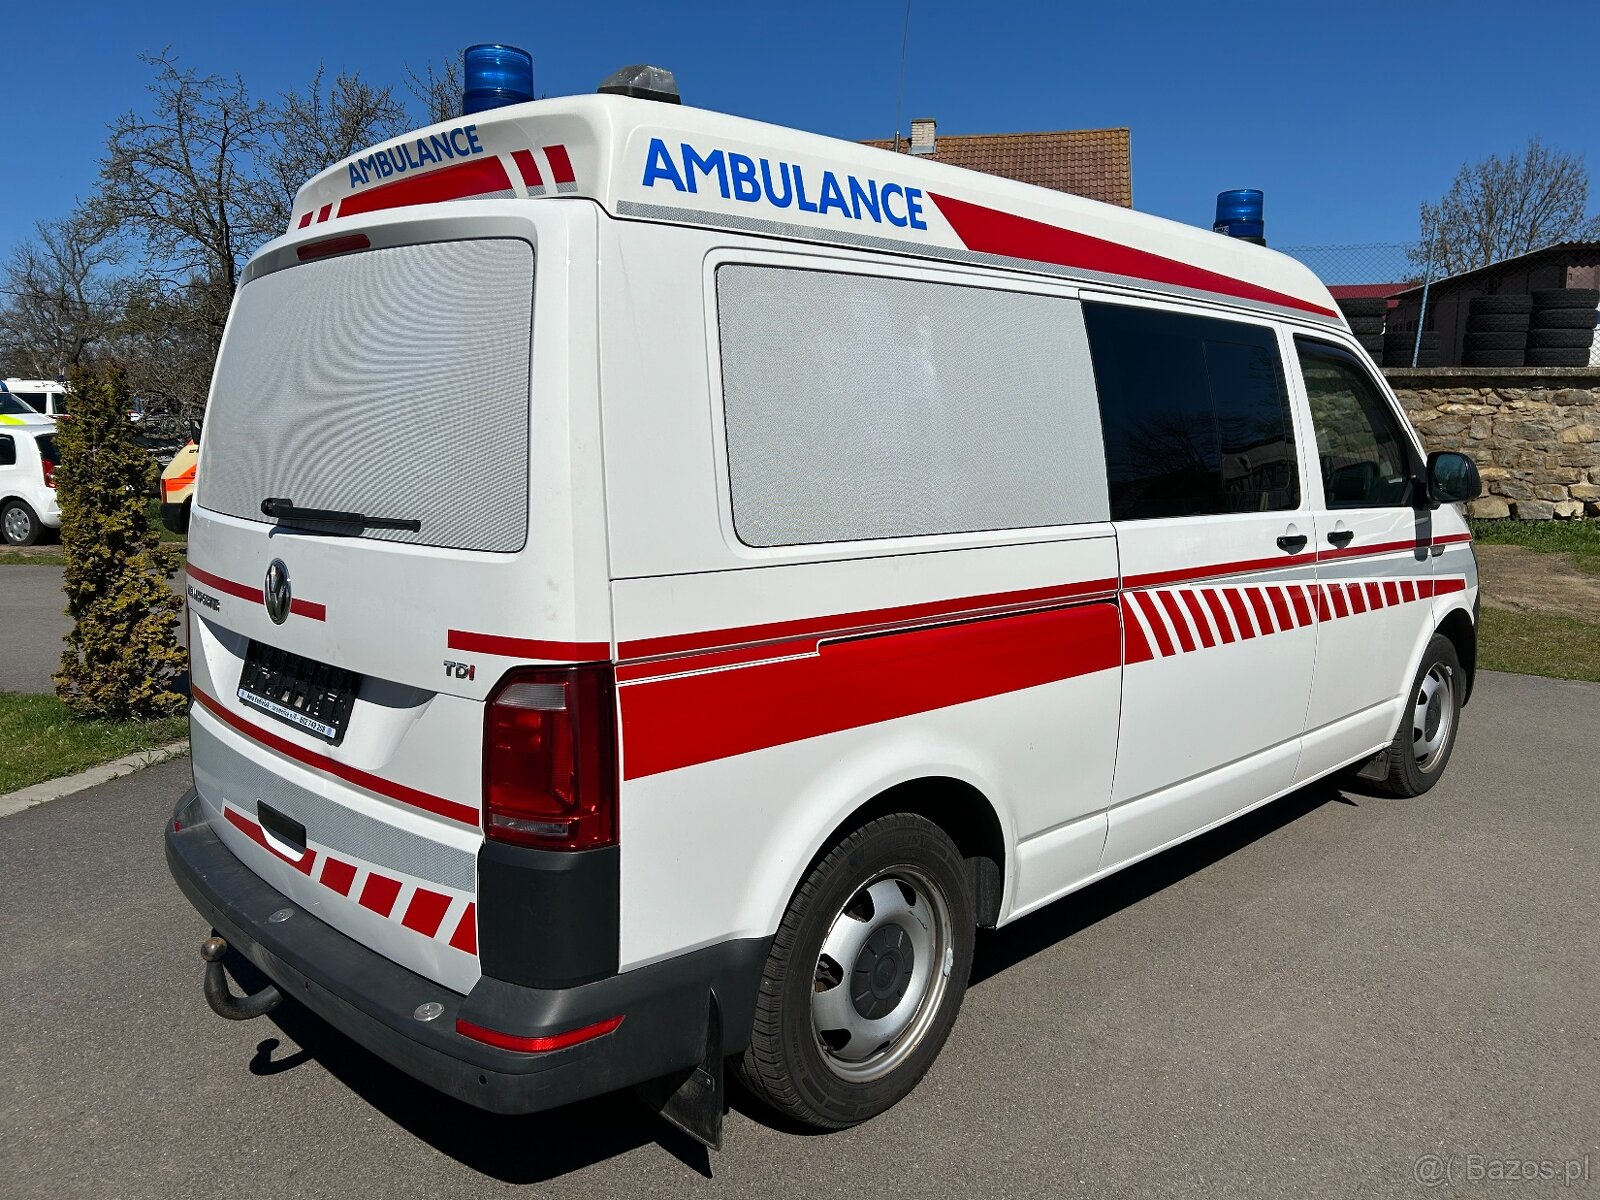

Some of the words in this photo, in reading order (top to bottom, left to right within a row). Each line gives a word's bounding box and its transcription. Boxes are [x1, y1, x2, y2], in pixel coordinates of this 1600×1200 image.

[348, 123, 484, 188] AMBULANCE
[642, 137, 928, 231] AMBULANCE
[443, 659, 476, 682] TDI
